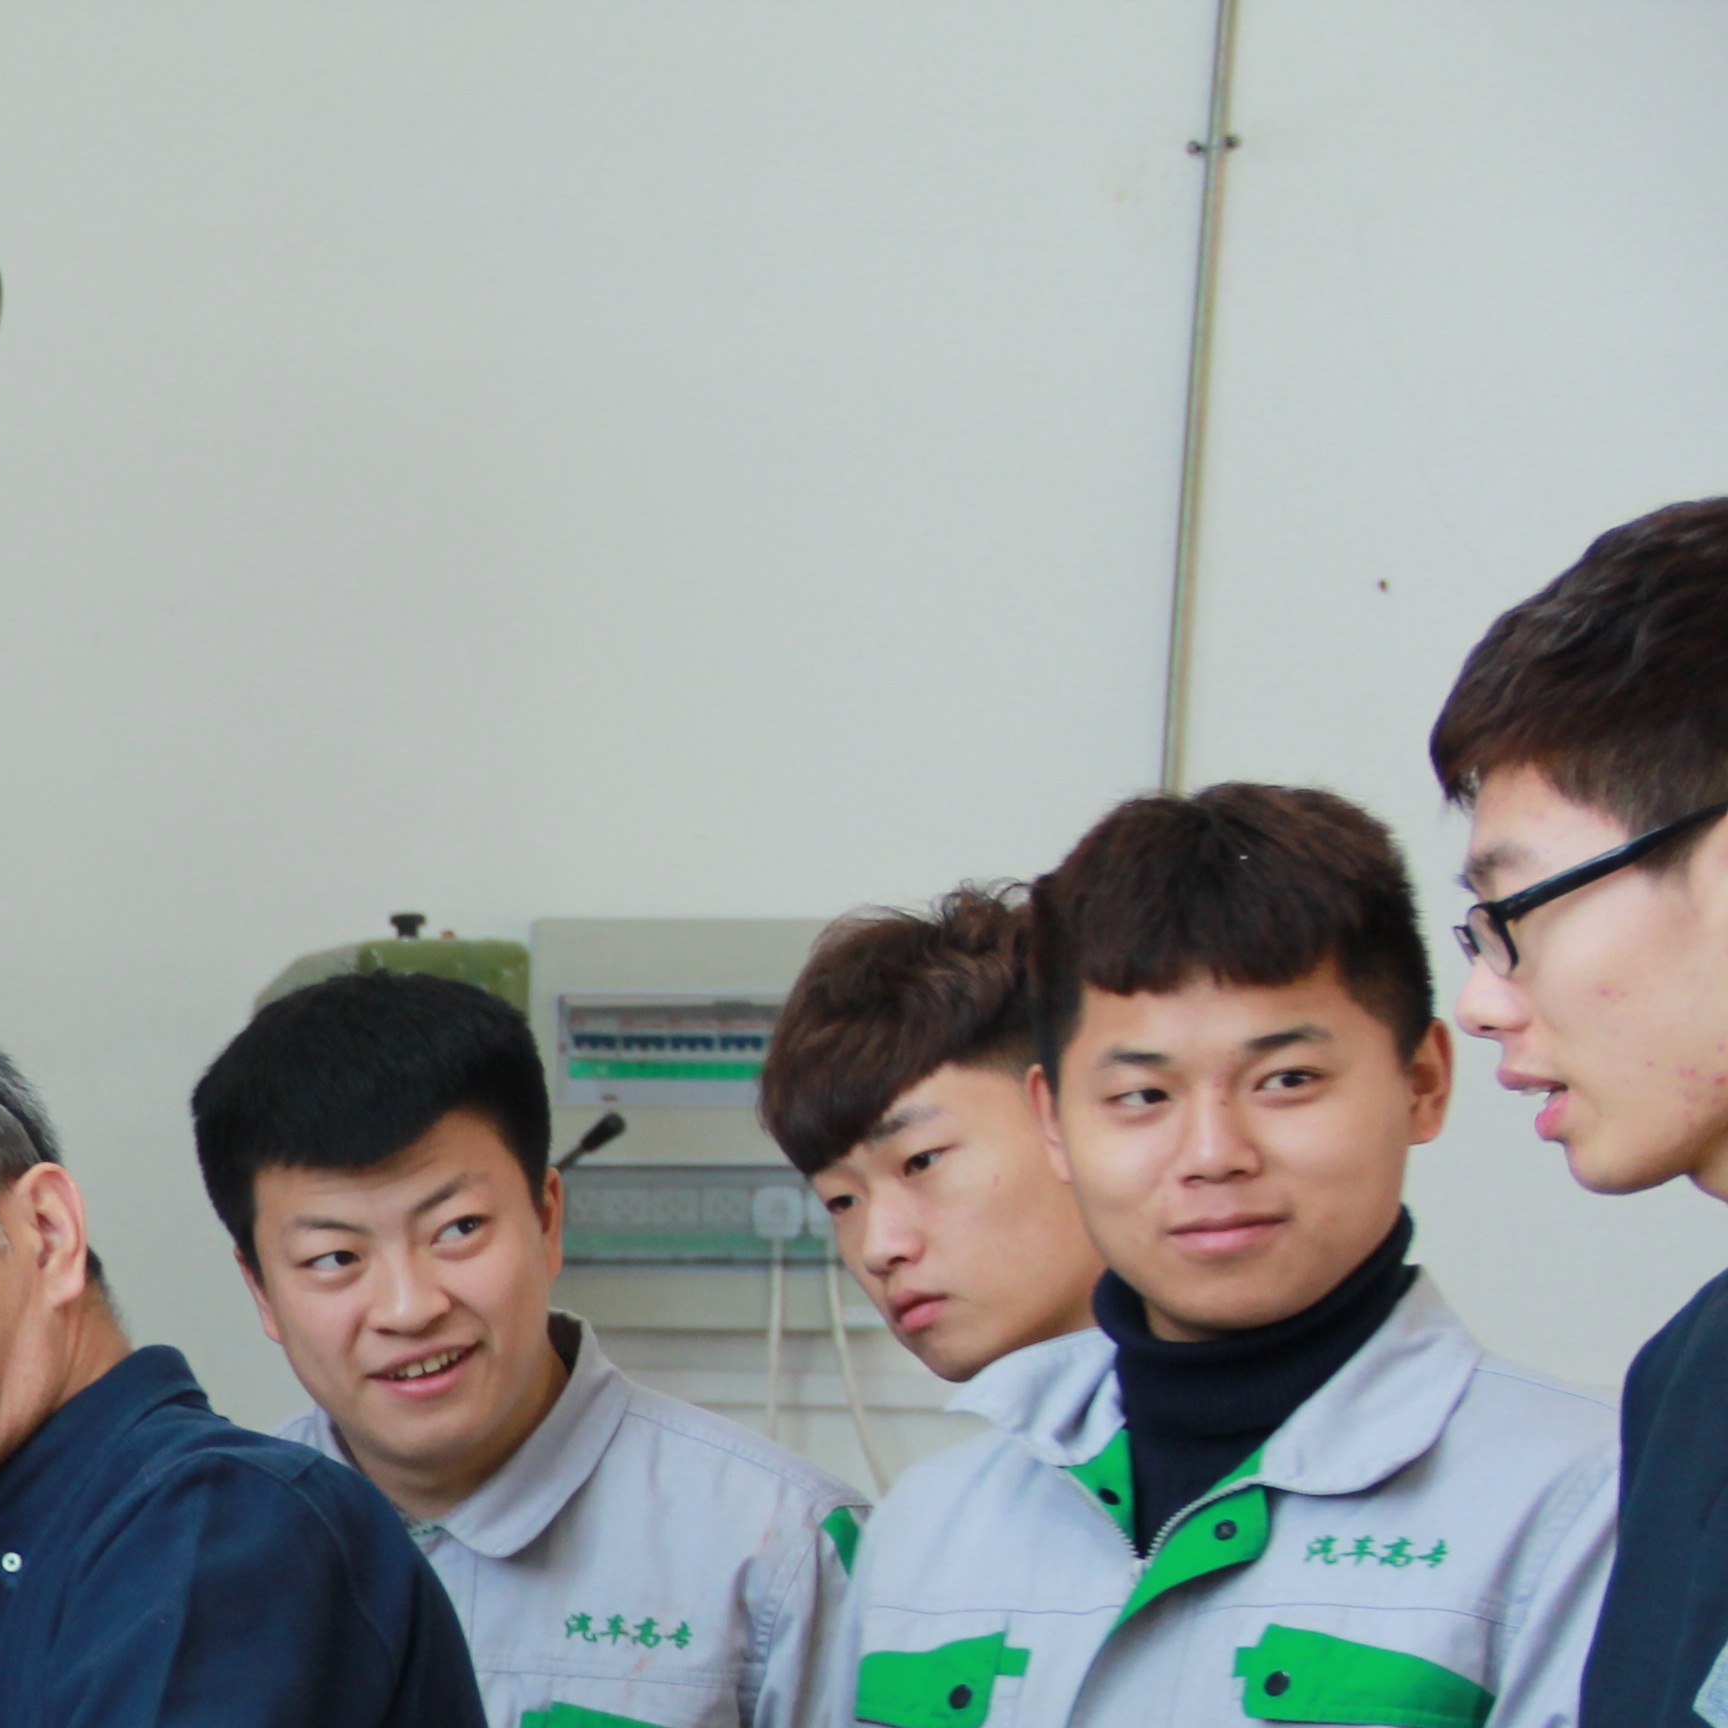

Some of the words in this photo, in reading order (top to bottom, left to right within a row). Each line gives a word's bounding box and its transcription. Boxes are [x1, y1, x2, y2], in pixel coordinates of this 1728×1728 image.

[1305, 1533, 1450, 1569] 汽车高专
[564, 1611, 694, 1650] 汽车高专
